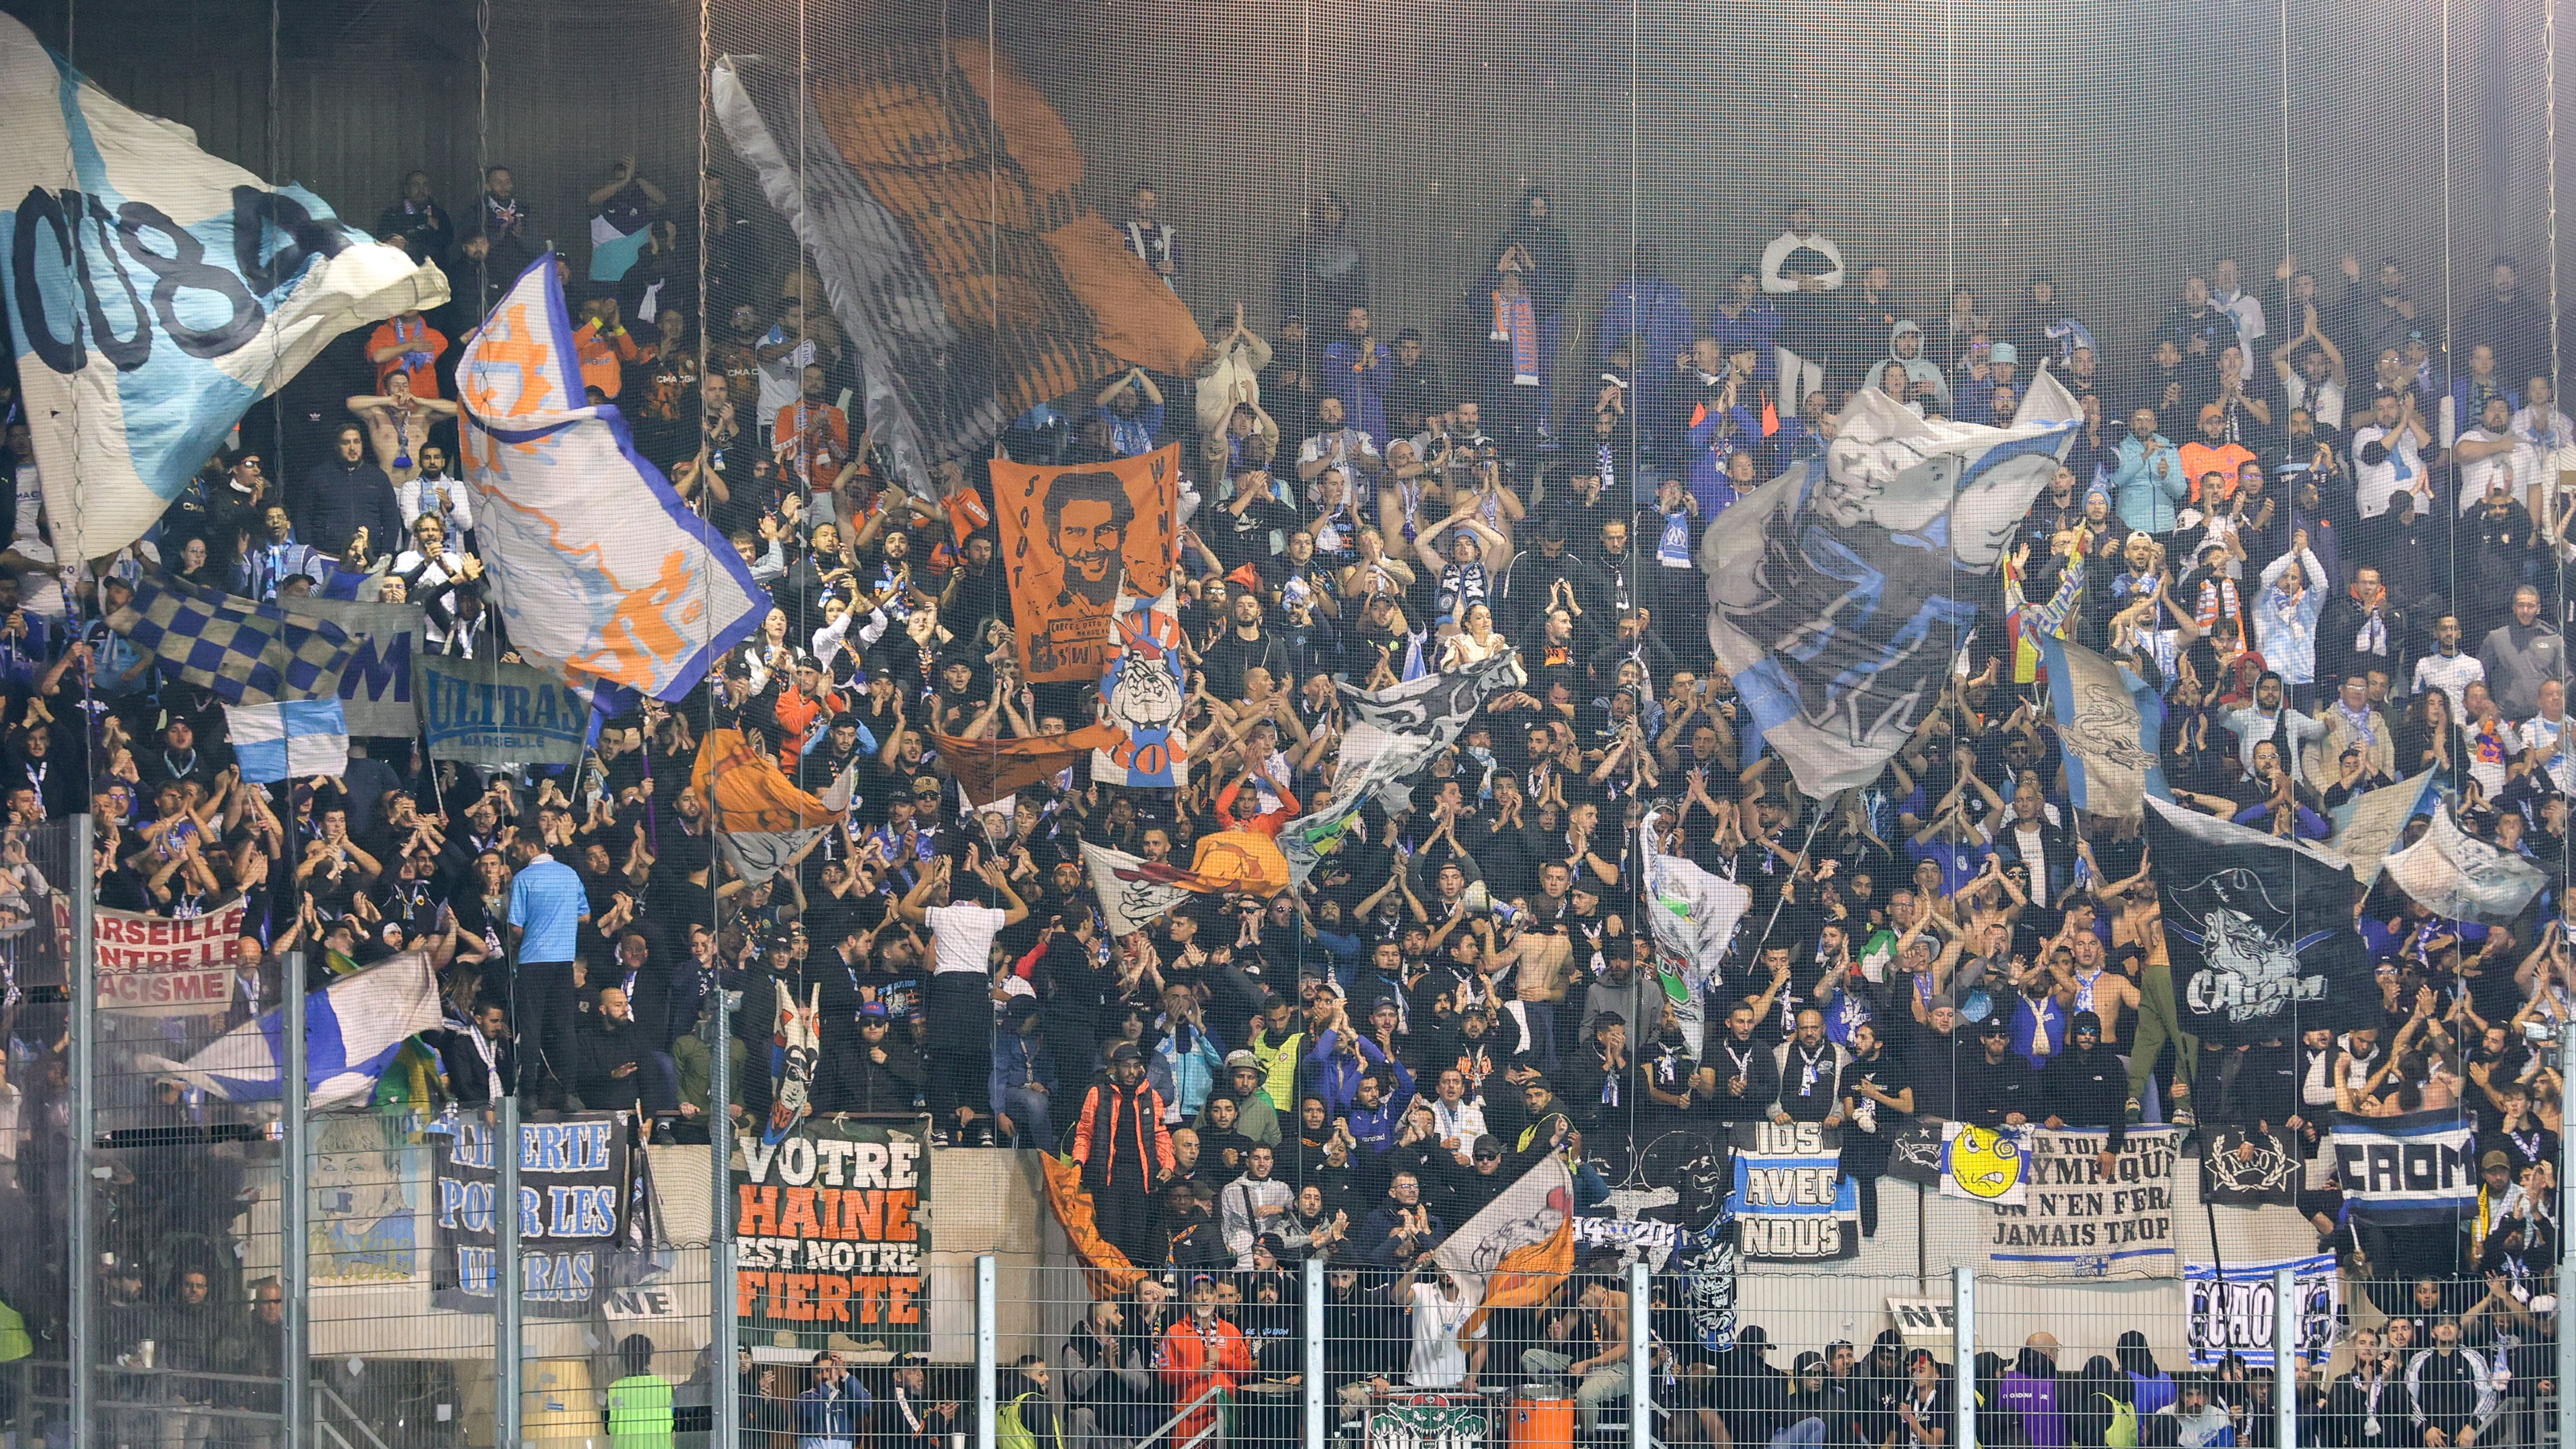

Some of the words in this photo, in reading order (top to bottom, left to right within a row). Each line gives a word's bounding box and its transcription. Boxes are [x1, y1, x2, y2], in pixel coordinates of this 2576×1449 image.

[425, 668, 588, 733] ULTRAS
[460, 735, 545, 749] MARSEILLE
[97, 973, 226, 1002] ACISME
[739, 1136, 921, 1189] VOTRE
[2059, 1137, 2099, 1155] TOI
[1745, 1167, 1838, 1206] AVEC
[2039, 1193, 2103, 1216] N'EN
[548, 1185, 617, 1237] LES
[737, 1184, 918, 1241] HAINE
[1993, 1222, 2096, 1246] JAMAIS
[737, 1236, 800, 1269] EST
[807, 1241, 918, 1273] NOTRE
[737, 1271, 919, 1324] FIERTE
